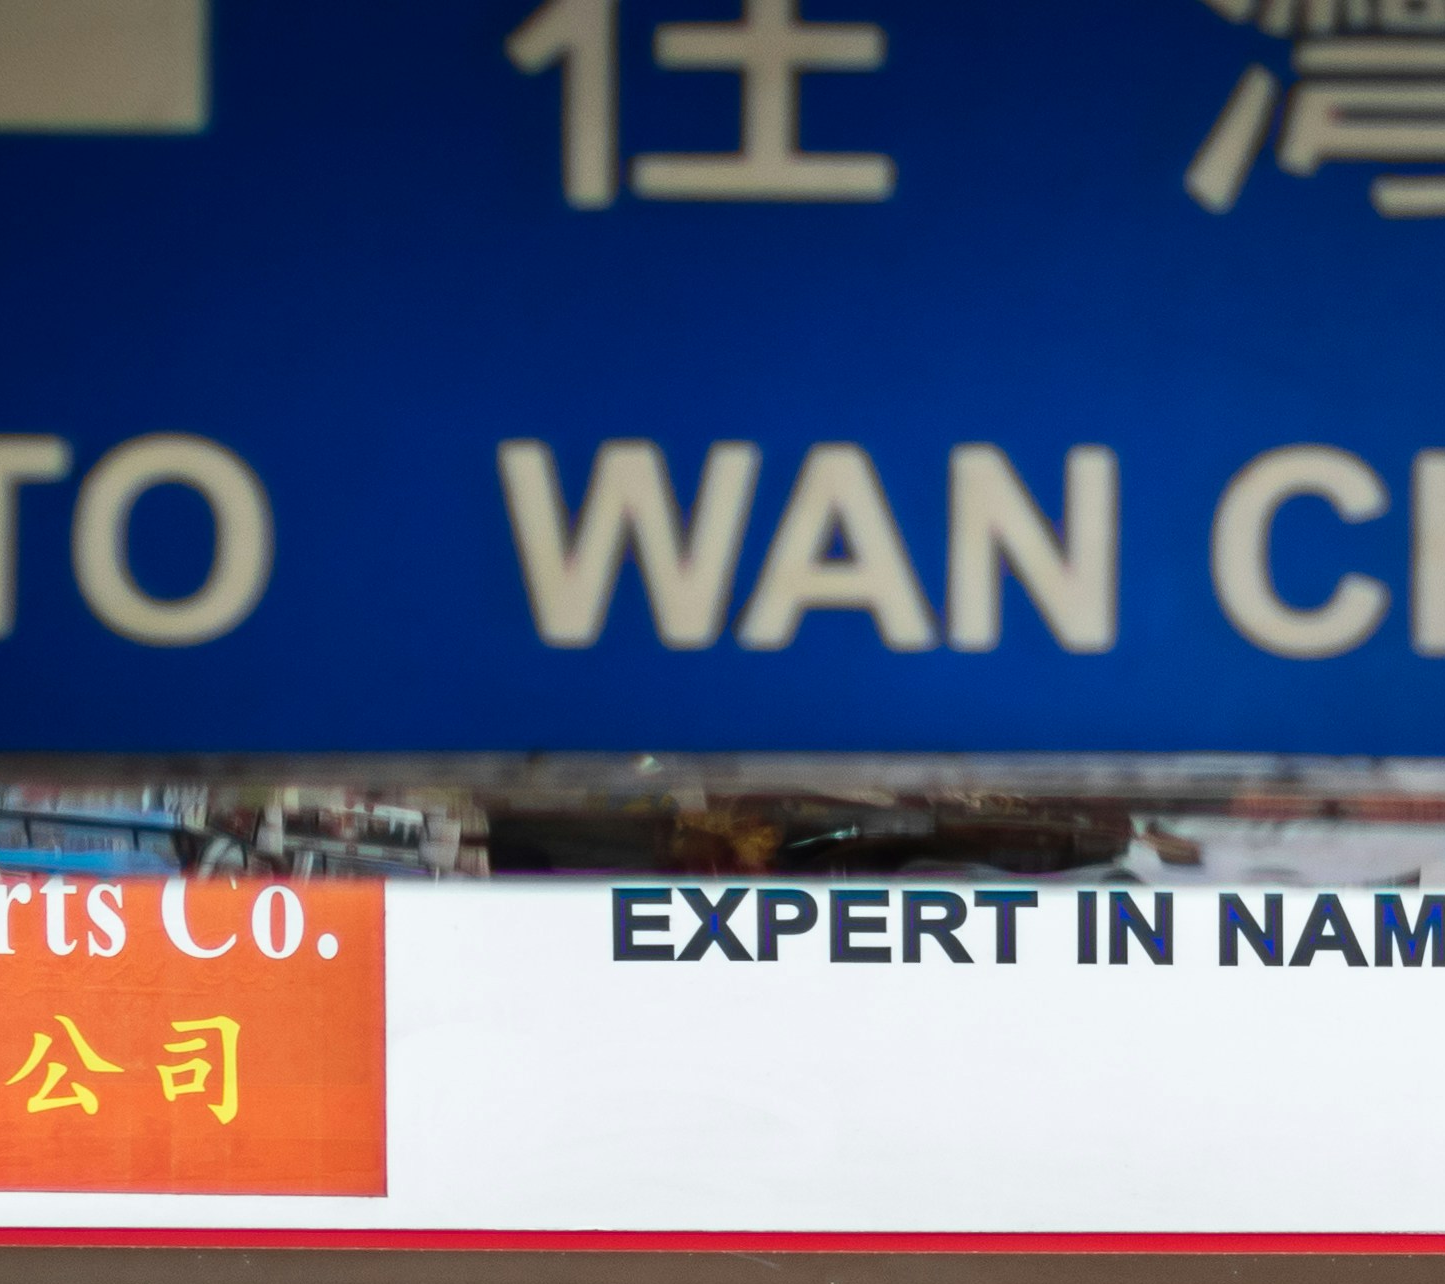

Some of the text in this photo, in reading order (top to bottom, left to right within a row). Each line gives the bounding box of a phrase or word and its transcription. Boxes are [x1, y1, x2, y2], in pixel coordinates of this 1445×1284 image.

[494, 439, 1119, 654] WAN
[161, 873, 340, 960] Co.
[611, 887, 1038, 965] EXPERT
[1077, 892, 1174, 967] IN
